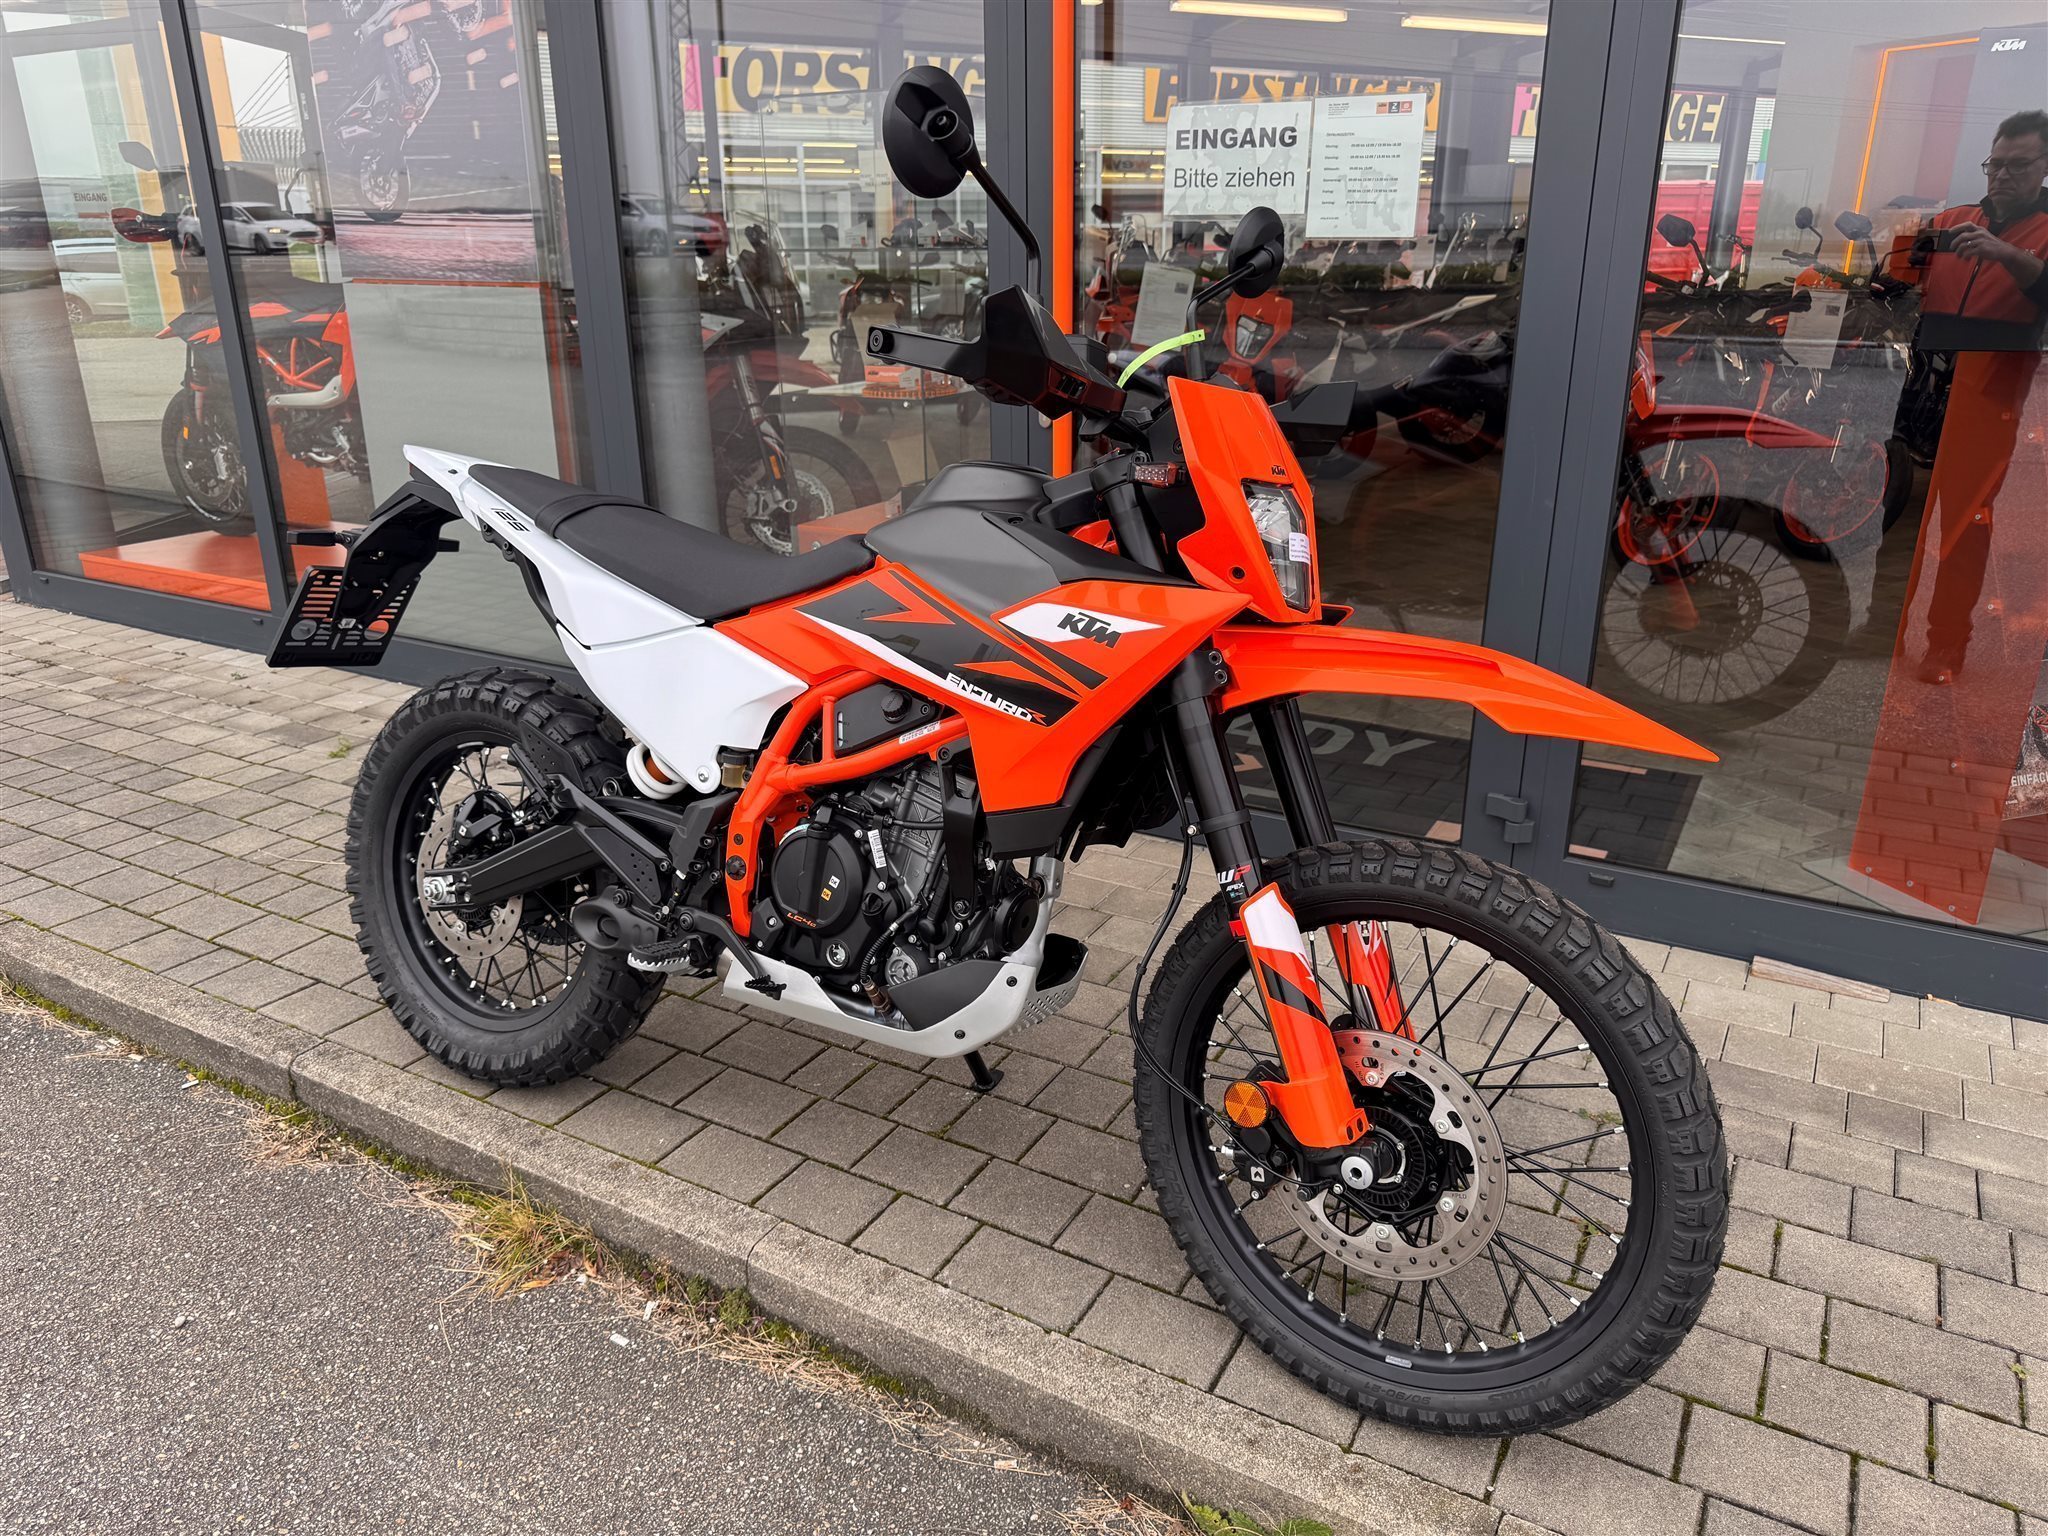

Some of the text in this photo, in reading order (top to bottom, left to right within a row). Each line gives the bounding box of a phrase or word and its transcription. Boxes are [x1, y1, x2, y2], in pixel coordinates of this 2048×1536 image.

[1990, 38, 2027, 52] KTM
[1176, 126, 1298, 151] EINGANG
[1173, 168, 1296, 188] Bitte ziehen
[73, 192, 108, 202] EINGANG
[1271, 464, 1286, 476] KTM
[1057, 612, 1121, 649] KTM
[945, 672, 1033, 722] ENDURO
[1217, 864, 1252, 885] WP
[1226, 882, 1245, 891] APEX
